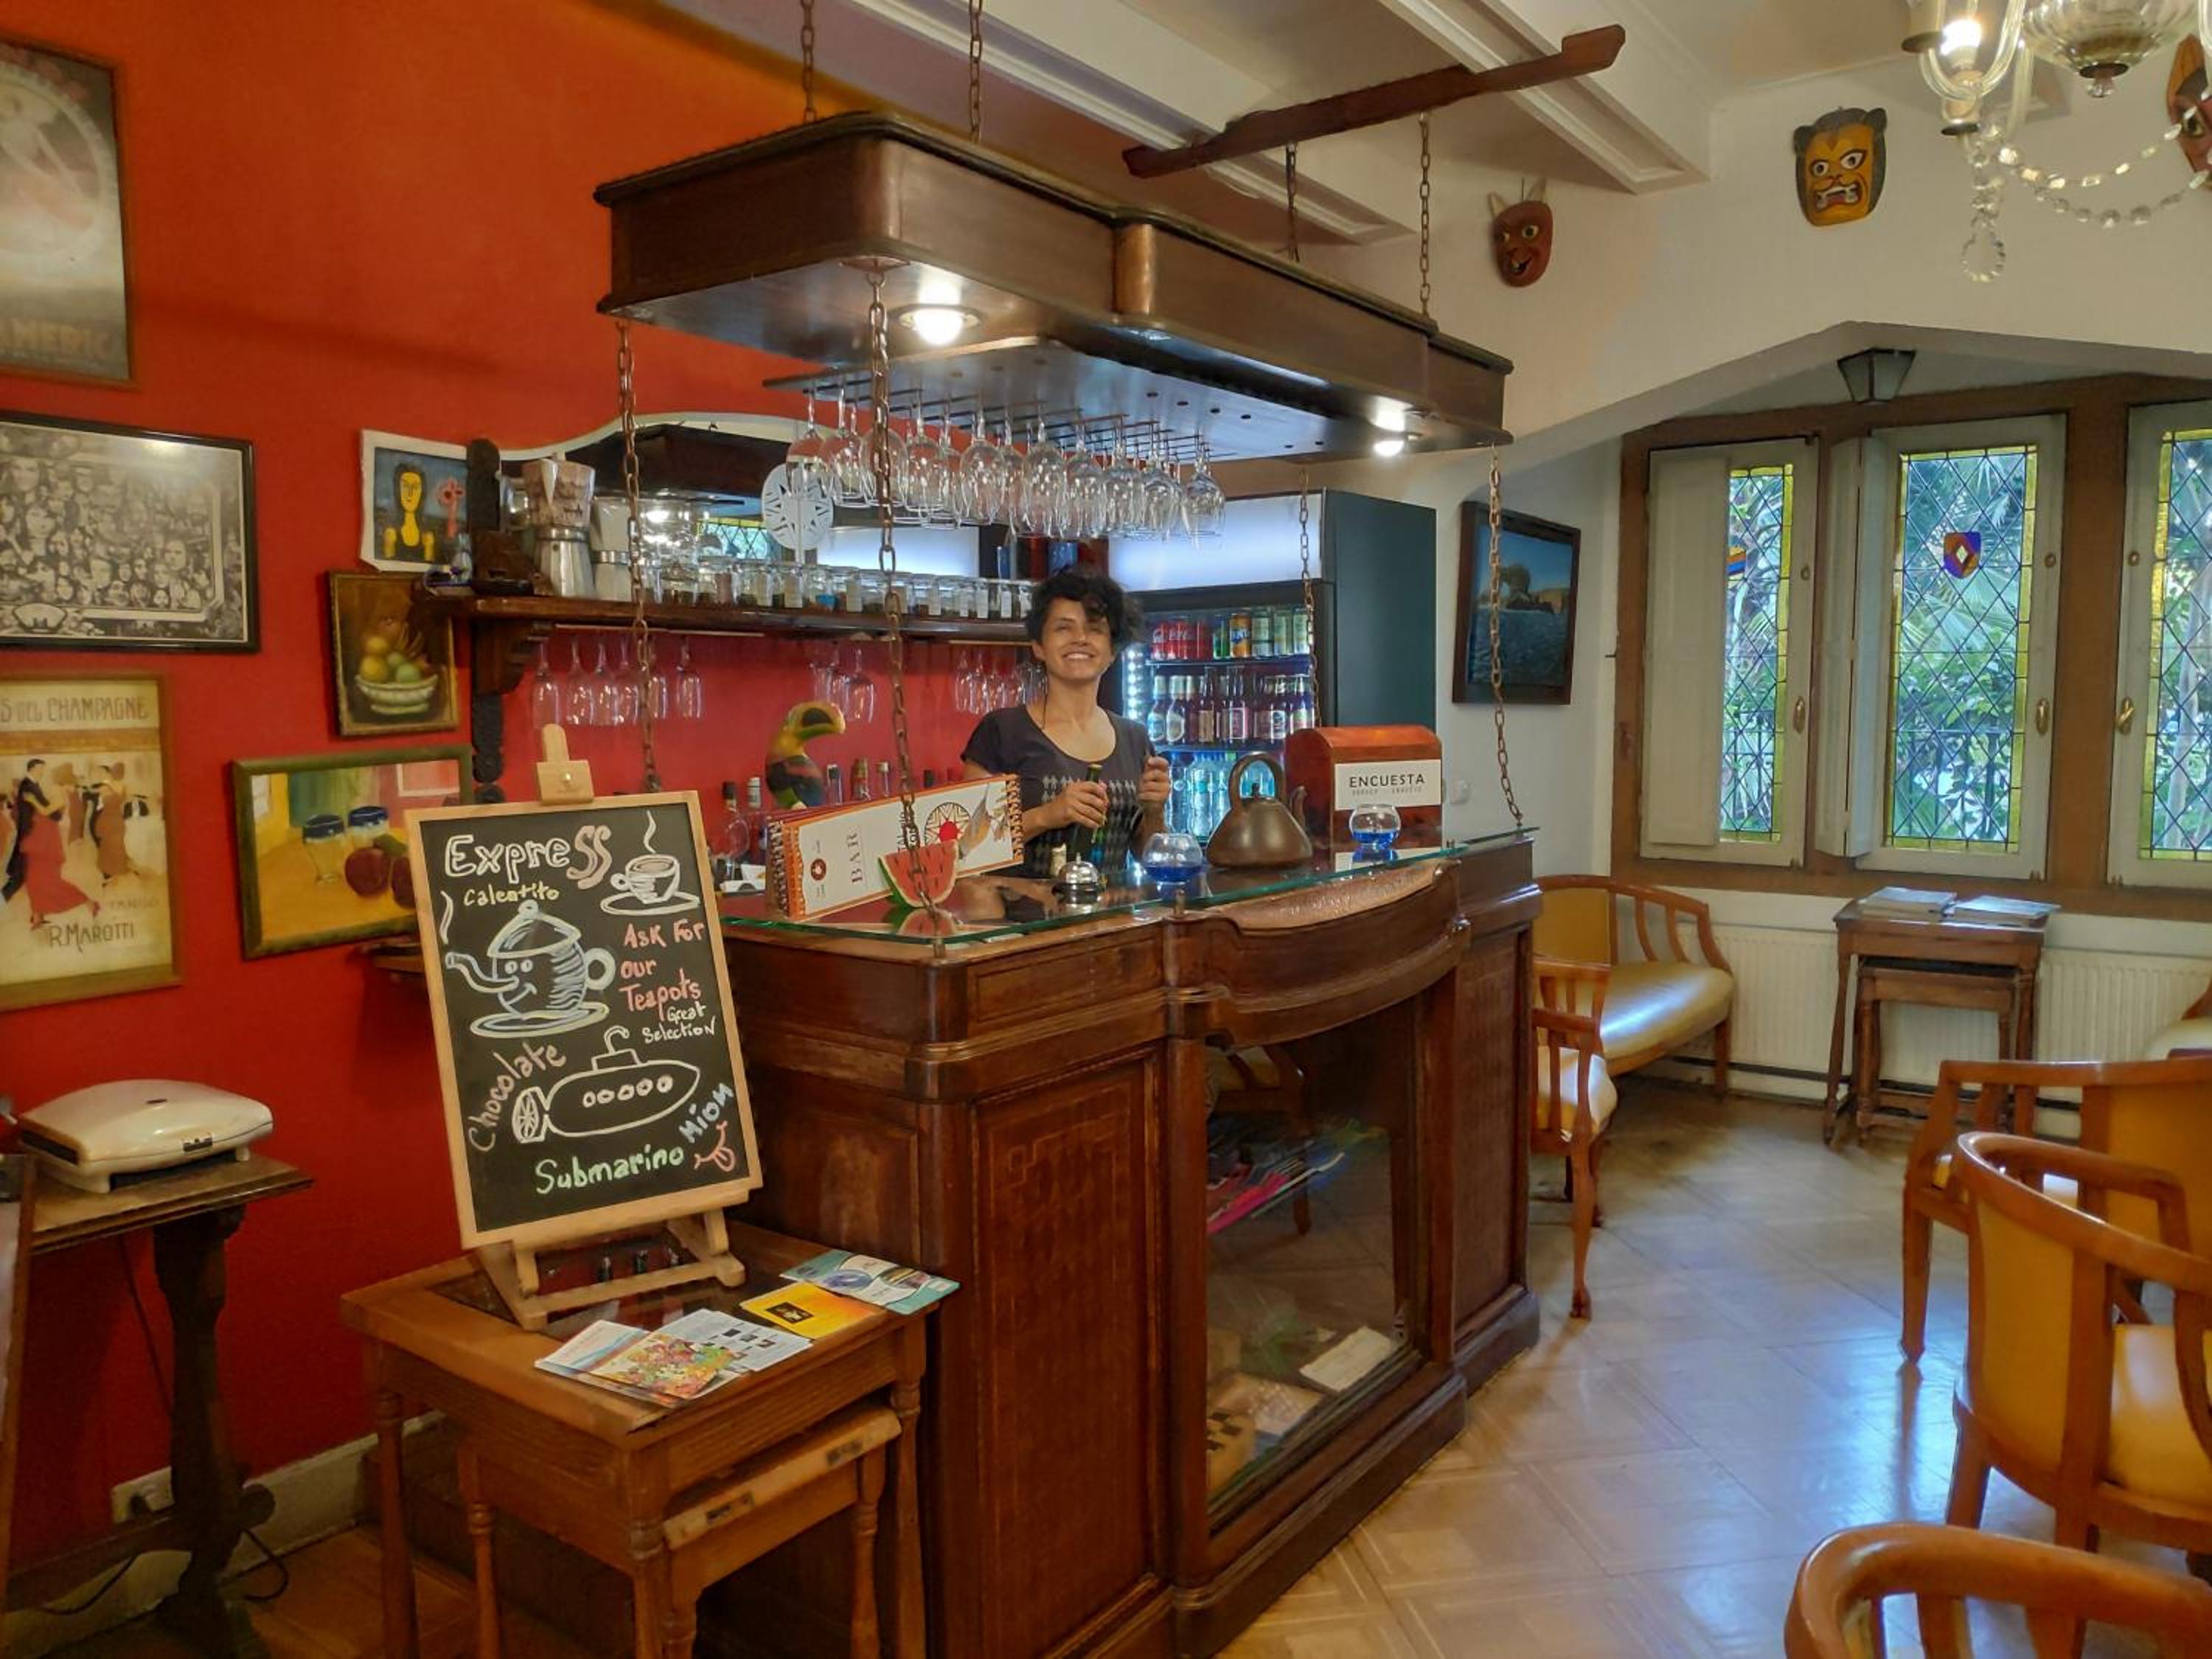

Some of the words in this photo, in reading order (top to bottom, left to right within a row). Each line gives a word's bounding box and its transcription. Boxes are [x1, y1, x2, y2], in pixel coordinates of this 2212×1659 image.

[46, 696, 150, 721] CHAMPAGNE
[1349, 773, 1425, 788] ENCUESTA
[846, 832, 863, 883] BAR
[619, 967, 701, 1021] Teapots
[667, 1001, 706, 1024] Great
[467, 1042, 567, 1152] Chocolate
[535, 1144, 684, 1194] Submarino
